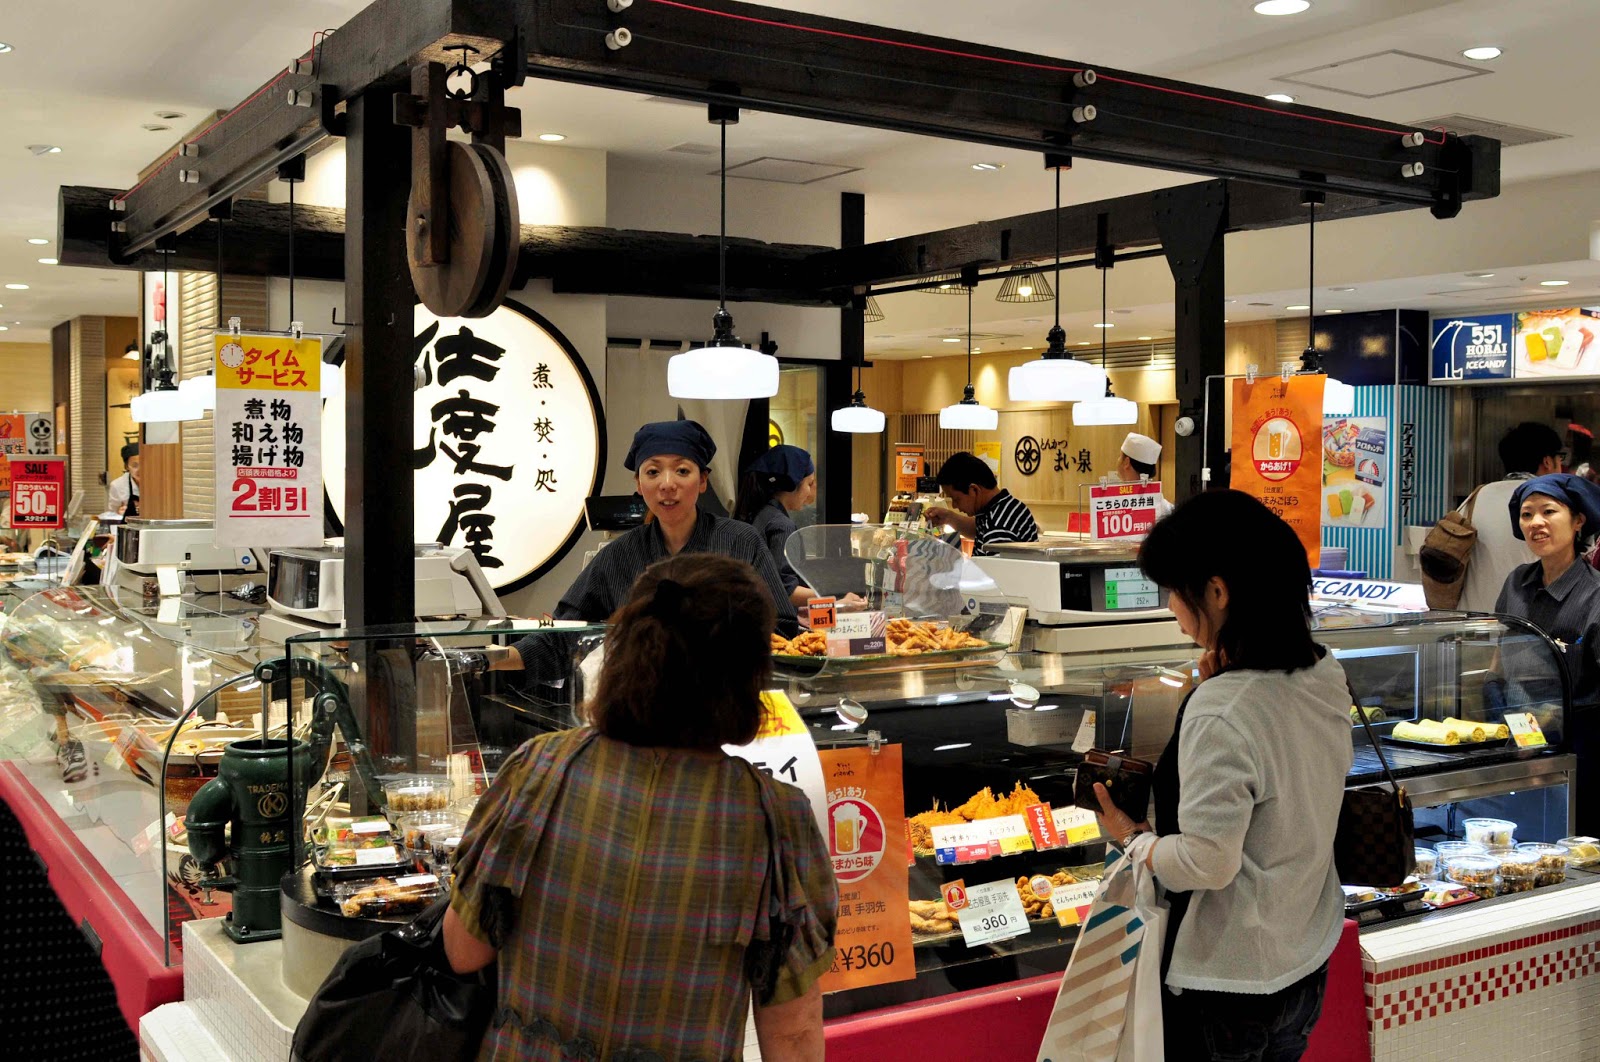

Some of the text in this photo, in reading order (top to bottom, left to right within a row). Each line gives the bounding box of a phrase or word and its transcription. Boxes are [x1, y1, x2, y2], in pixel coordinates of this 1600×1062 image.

[1471, 324, 1502, 345] 551
[245, 347, 299, 367] タイム
[1465, 342, 1508, 357] HORAI
[235, 367, 308, 388] サービス
[243, 397, 292, 421] 煮物
[231, 421, 304, 445] 和え物
[1040, 438, 1069, 451] とんかつ
[231, 444, 304, 468] 揚げ物
[1053, 448, 1093, 474] まい泉
[24, 463, 49, 475] SALE
[1259, 461, 1292, 472] からあげ!
[1400, 423, 1418, 518] アイスキャンデー
[231, 478, 308, 512] 2割引
[1119, 485, 1134, 496] SALE
[1096, 496, 1154, 511] こちらのお弁当
[813, 608, 833, 626] BEST 1
[1033, 807, 1051, 845] できたて
[855, 900, 886, 916] 手羽先
[981, 913, 1008, 931] 360
